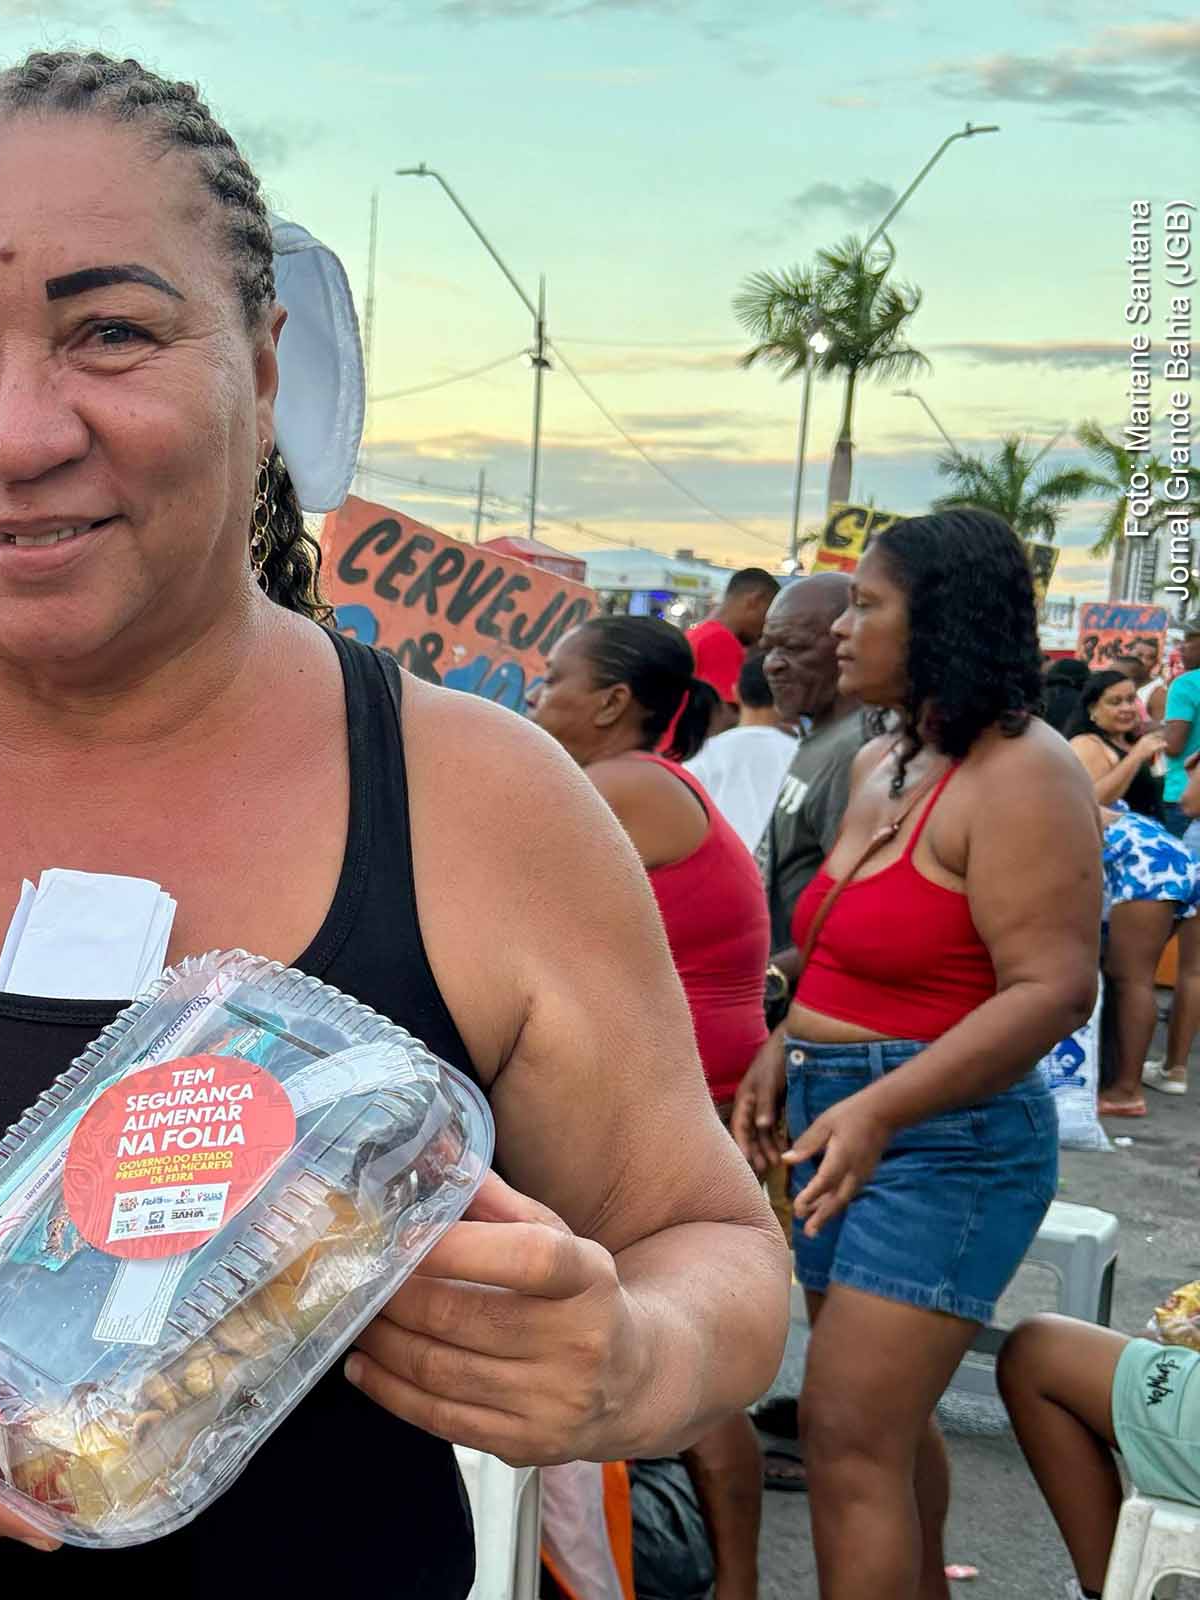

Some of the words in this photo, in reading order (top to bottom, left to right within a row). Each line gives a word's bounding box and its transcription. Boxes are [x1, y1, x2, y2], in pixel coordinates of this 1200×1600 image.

[171, 1067, 215, 1087] TEM
[125, 1083, 253, 1113] SEGURANÇA
[122, 1104, 242, 1133] ALIMENTAR
[116, 1132, 156, 1158] NA
[160, 1123, 246, 1152] FOLIA
[115, 1166, 163, 1180] PRESENTE
[163, 1164, 180, 1174] NA
[180, 1160, 233, 1173] MICARETA
[118, 1155, 171, 1172] GOVERNO
[172, 1153, 191, 1163] DO
[191, 1150, 233, 1161] ESTADO
[150, 1175, 164, 1184] DE
[165, 1172, 194, 1183] FEIRA
